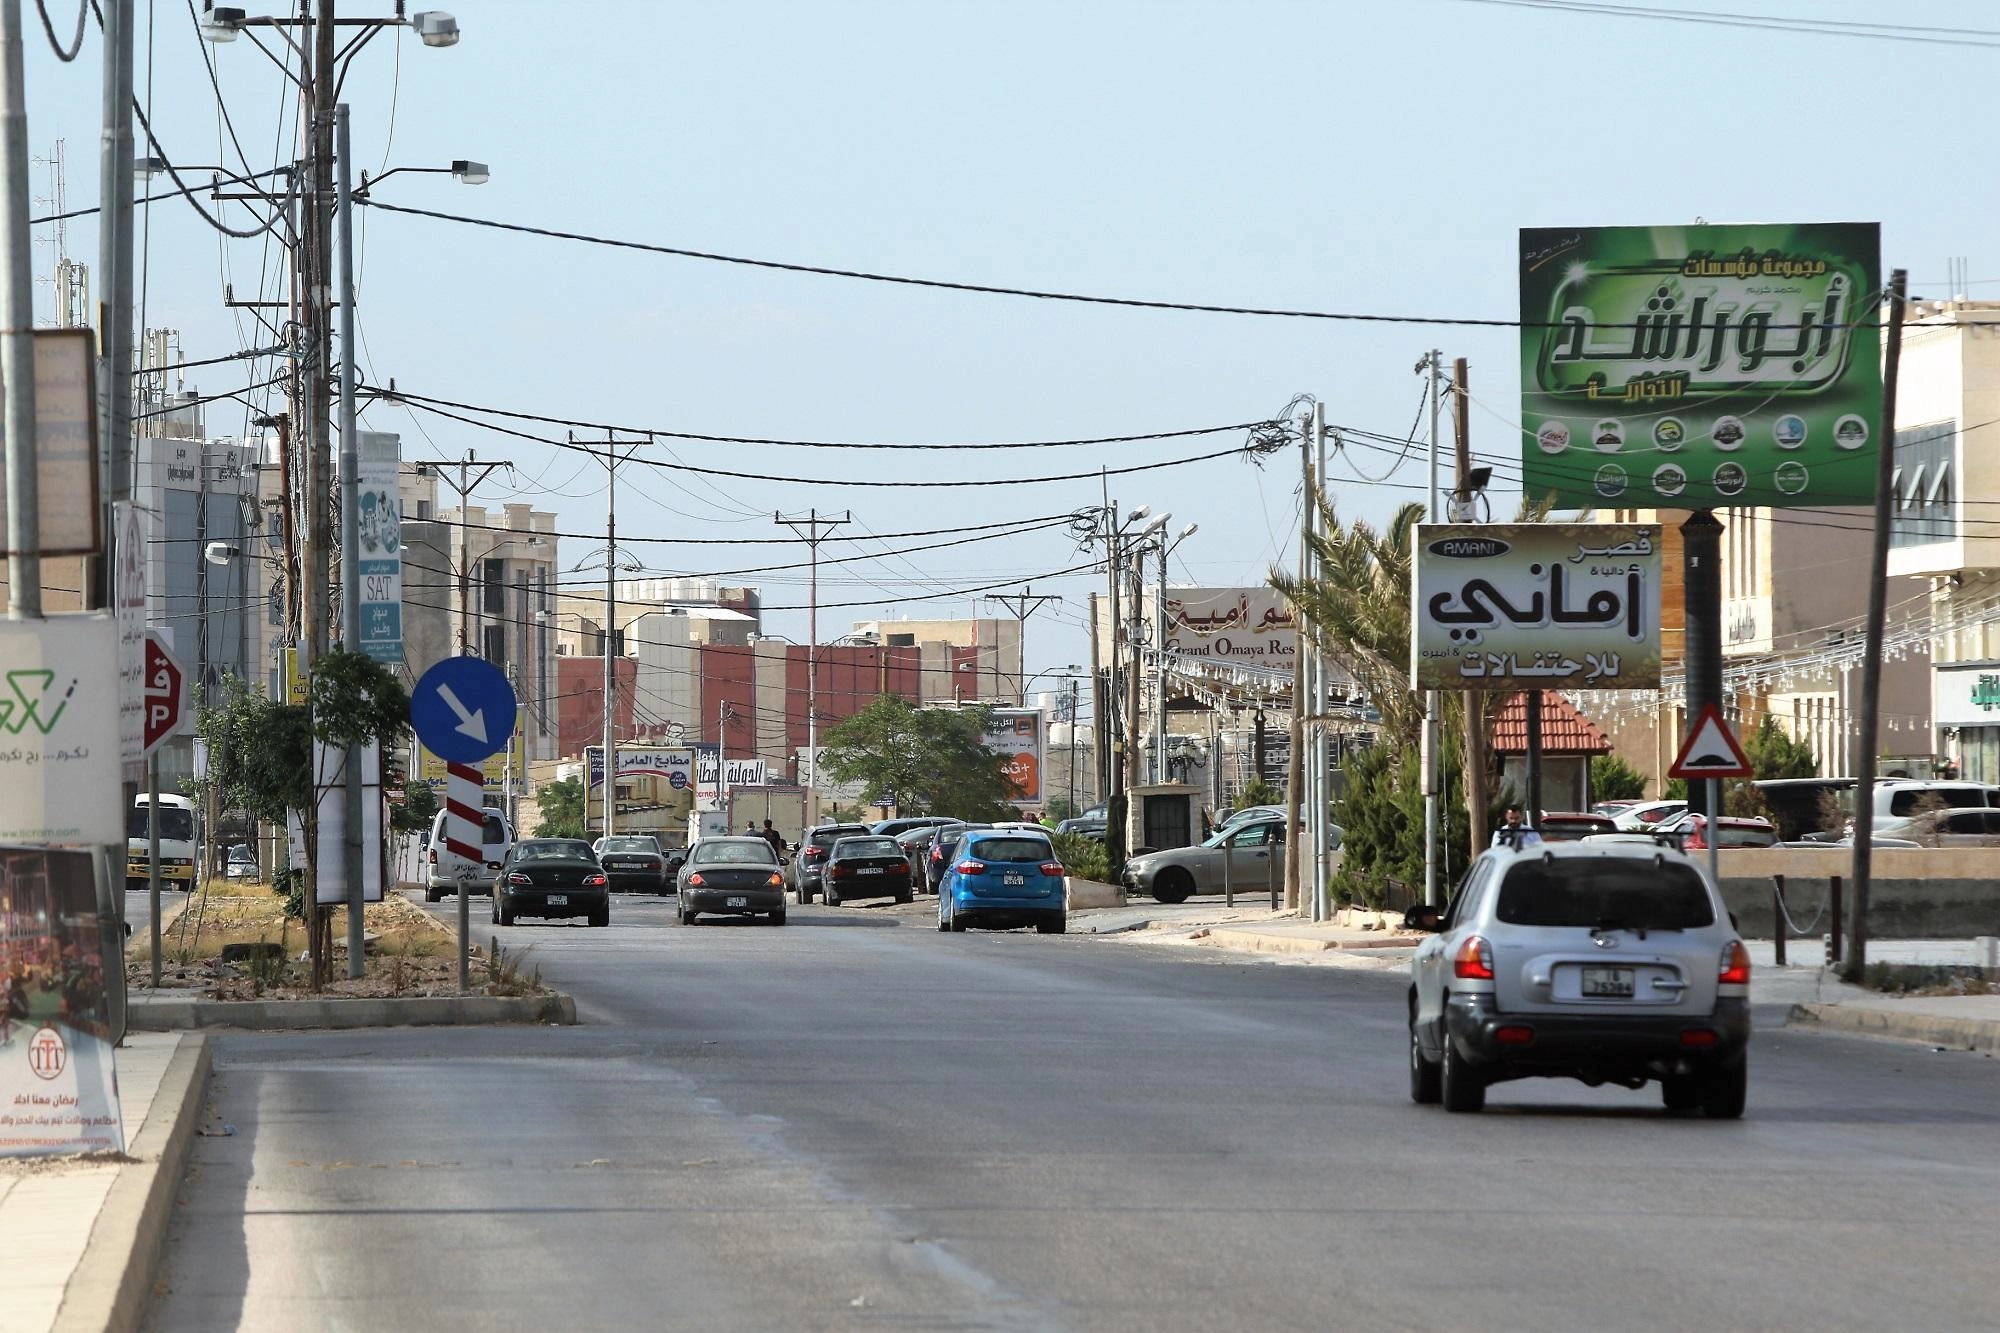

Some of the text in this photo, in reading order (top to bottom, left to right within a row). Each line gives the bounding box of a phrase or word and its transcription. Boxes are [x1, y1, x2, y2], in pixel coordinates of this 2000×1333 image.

[1684, 255, 1826, 279] مجموعة مؤسسات
[1586, 378, 1682, 403] التجارية
[1443, 541, 1496, 556] AMANI
[1567, 529, 1653, 564] قصر
[366, 576, 392, 601] SAT
[1166, 592, 1250, 637] أمية
[1429, 563, 1643, 643] أماني
[1165, 638, 1210, 657] Grand
[1214, 637, 1265, 659] Omaya
[1459, 650, 1622, 685] للإحتفالات
[622, 754, 690, 768] مطابخ العامر
[53, 1094, 79, 1107] رمضان
